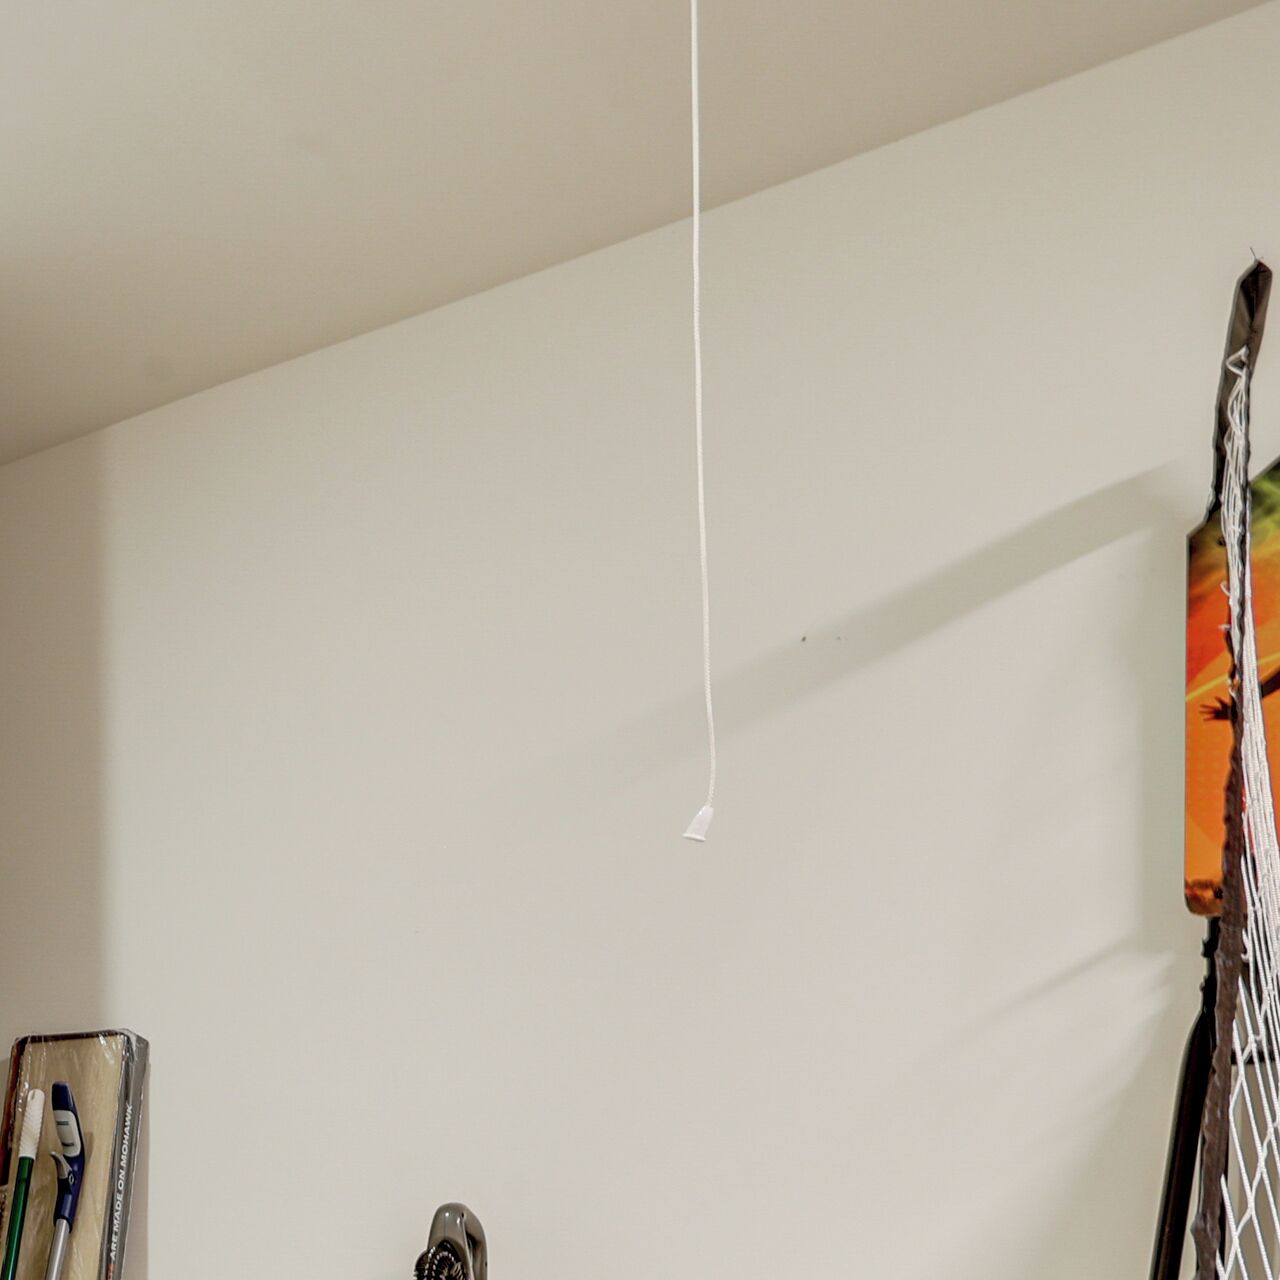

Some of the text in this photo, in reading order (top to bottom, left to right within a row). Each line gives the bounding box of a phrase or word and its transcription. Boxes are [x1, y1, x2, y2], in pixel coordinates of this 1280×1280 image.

[120, 1103, 133, 1166] MOHAWK
[118, 1171, 127, 1190] ON
[113, 1191, 124, 1231] MADE
[110, 1233, 119, 1261] ARE
